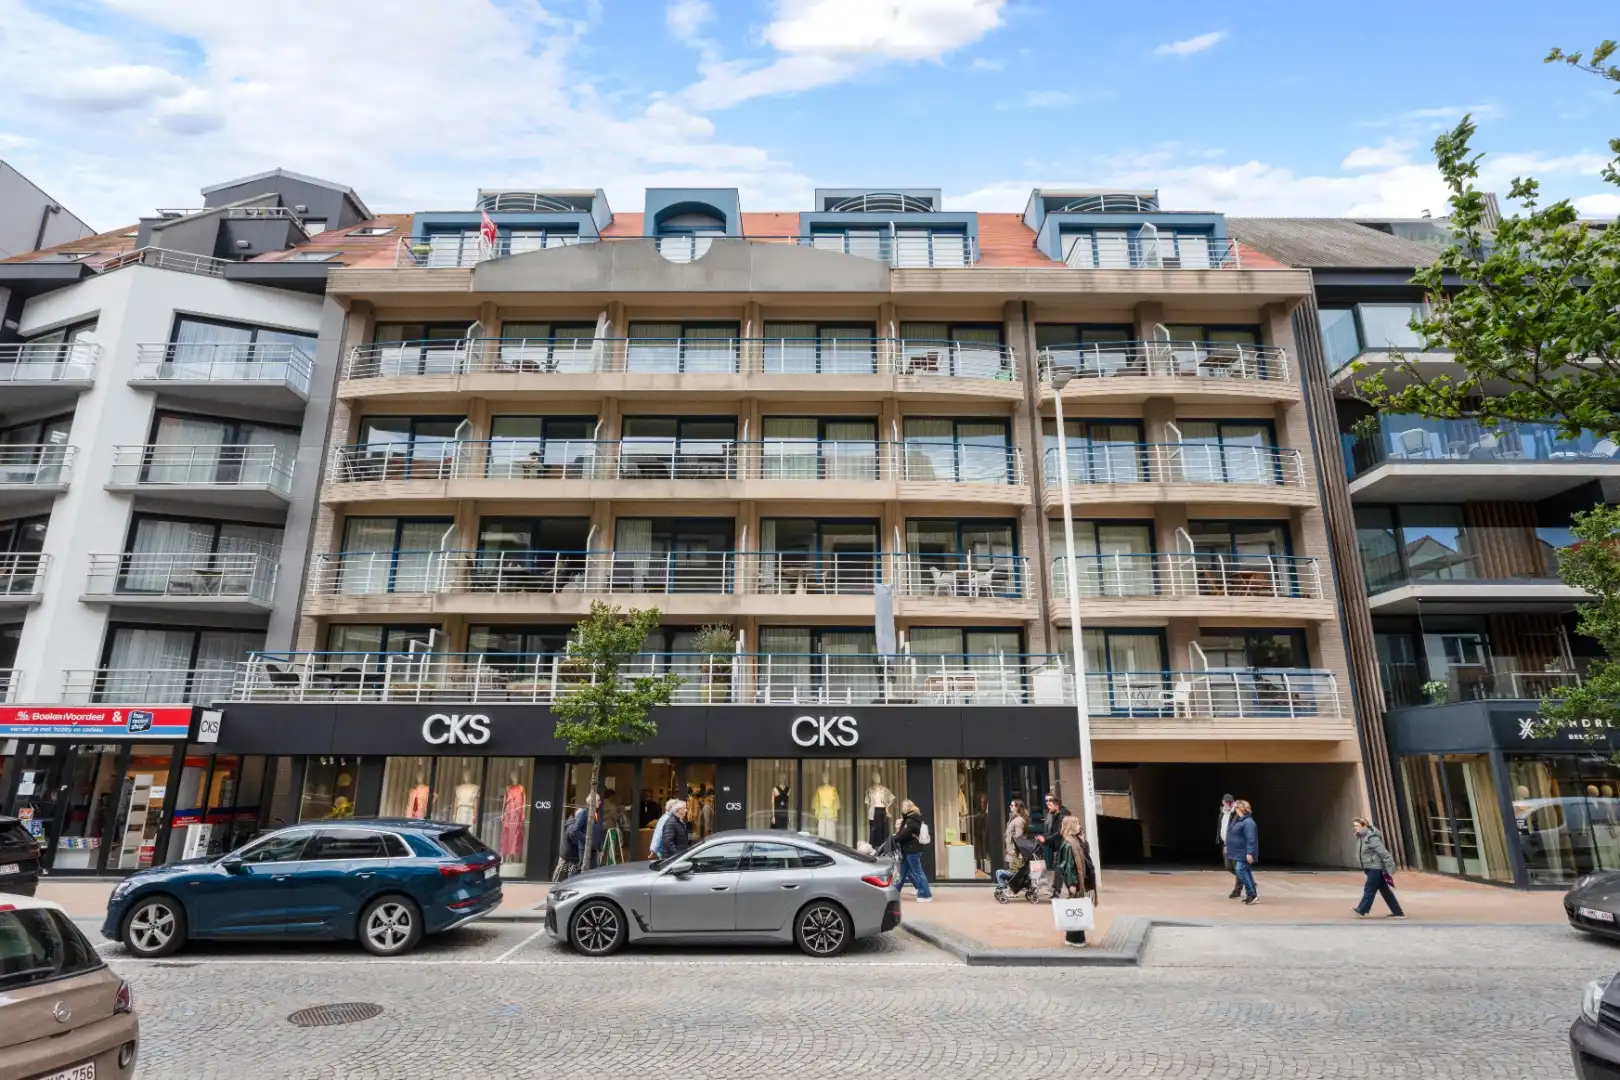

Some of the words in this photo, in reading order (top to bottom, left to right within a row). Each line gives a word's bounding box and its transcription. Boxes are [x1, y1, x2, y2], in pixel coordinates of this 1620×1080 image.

[32, 712, 105, 721] BoekenVoordeel
[112, 711, 123, 722] &
[200, 720, 219, 733] CKS
[1541, 718, 1620, 728] XANDRE
[422, 713, 491, 745] CKS
[791, 716, 859, 747] CKS
[536, 801, 551, 809] CKS
[726, 802, 742, 810] CKS
[1065, 908, 1083, 917] CKS
